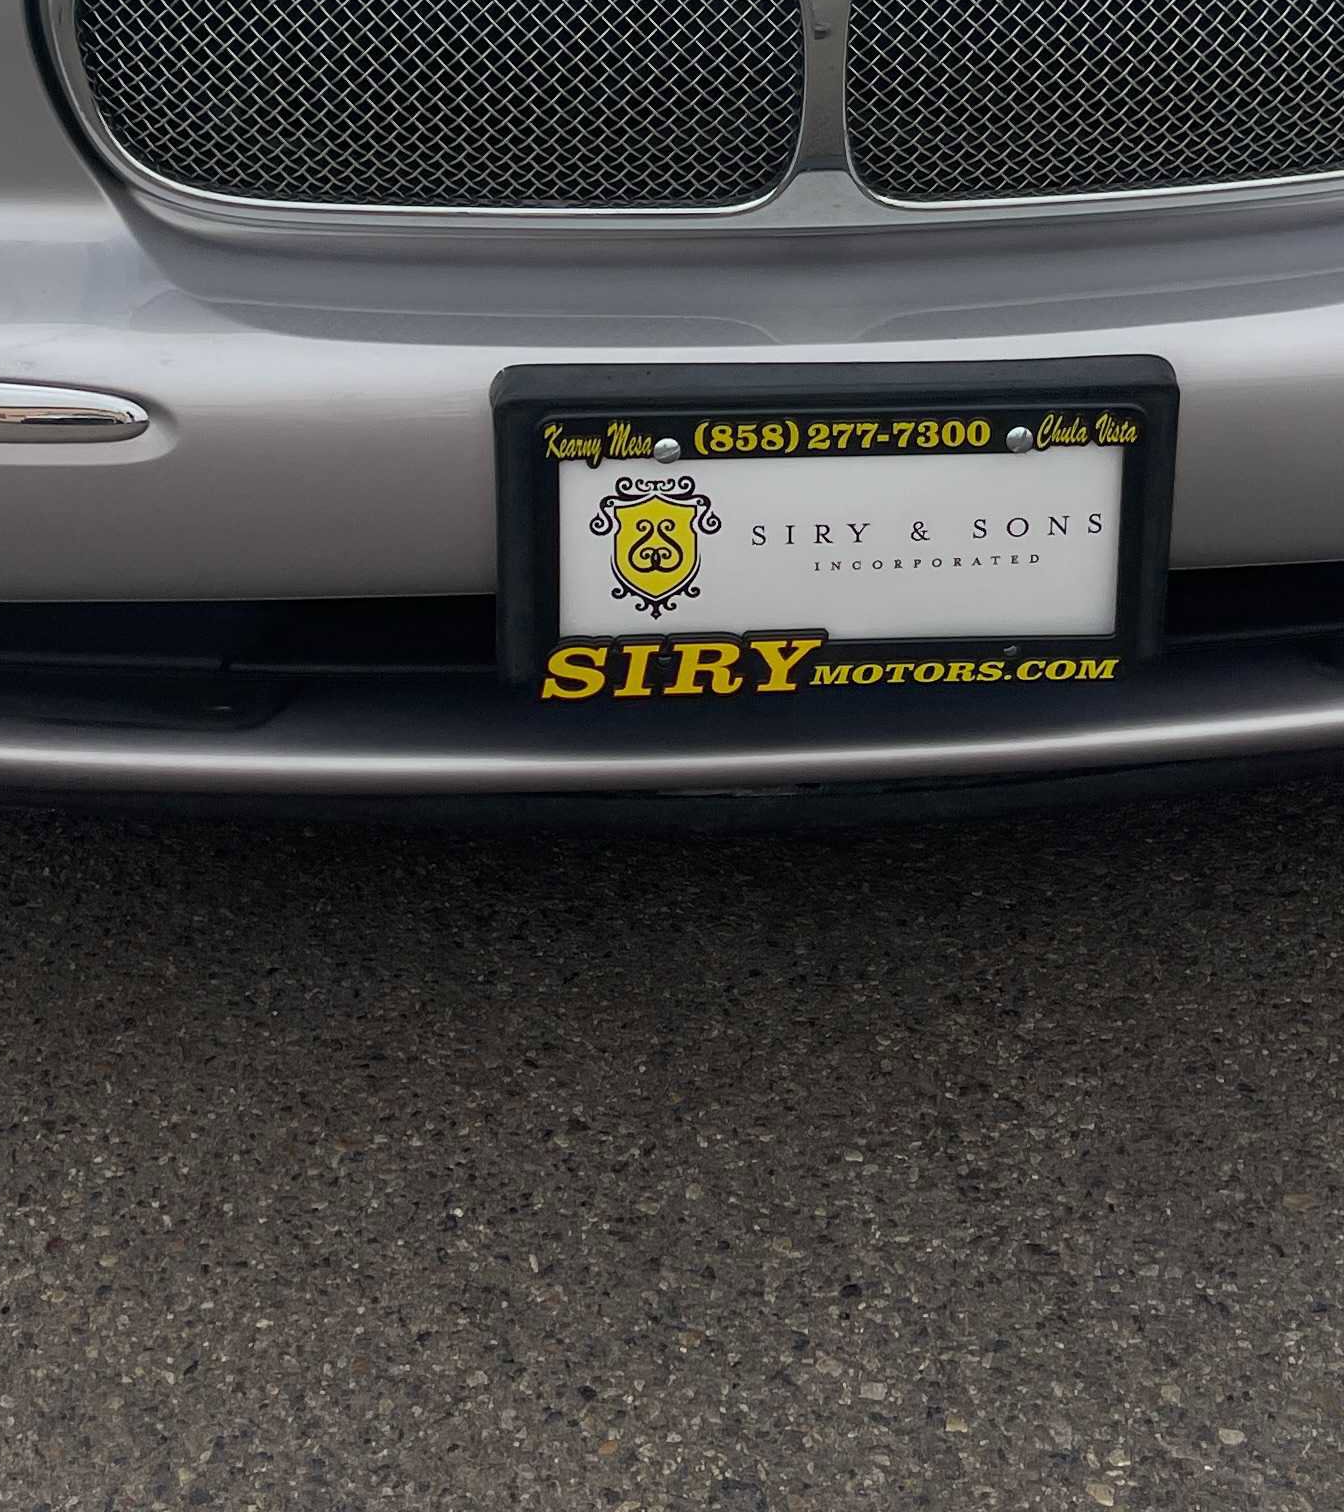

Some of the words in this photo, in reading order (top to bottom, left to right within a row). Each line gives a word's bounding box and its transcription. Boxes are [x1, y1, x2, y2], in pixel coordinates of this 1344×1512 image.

[544, 423, 602, 459] Kearny
[607, 422, 653, 457] Mesa
[694, 421, 799, 455] (858)
[808, 419, 991, 450] 277-7300
[1036, 413, 1089, 449] Chula
[1095, 413, 1138, 445] Vista
[751, 522, 871, 546] SIRY
[910, 521, 931, 542] &
[972, 513, 1104, 540] SONS
[814, 553, 1041, 572] INCORPORATED
[541, 638, 823, 700] SIRY
[809, 658, 1120, 686] MOTORS.COM
